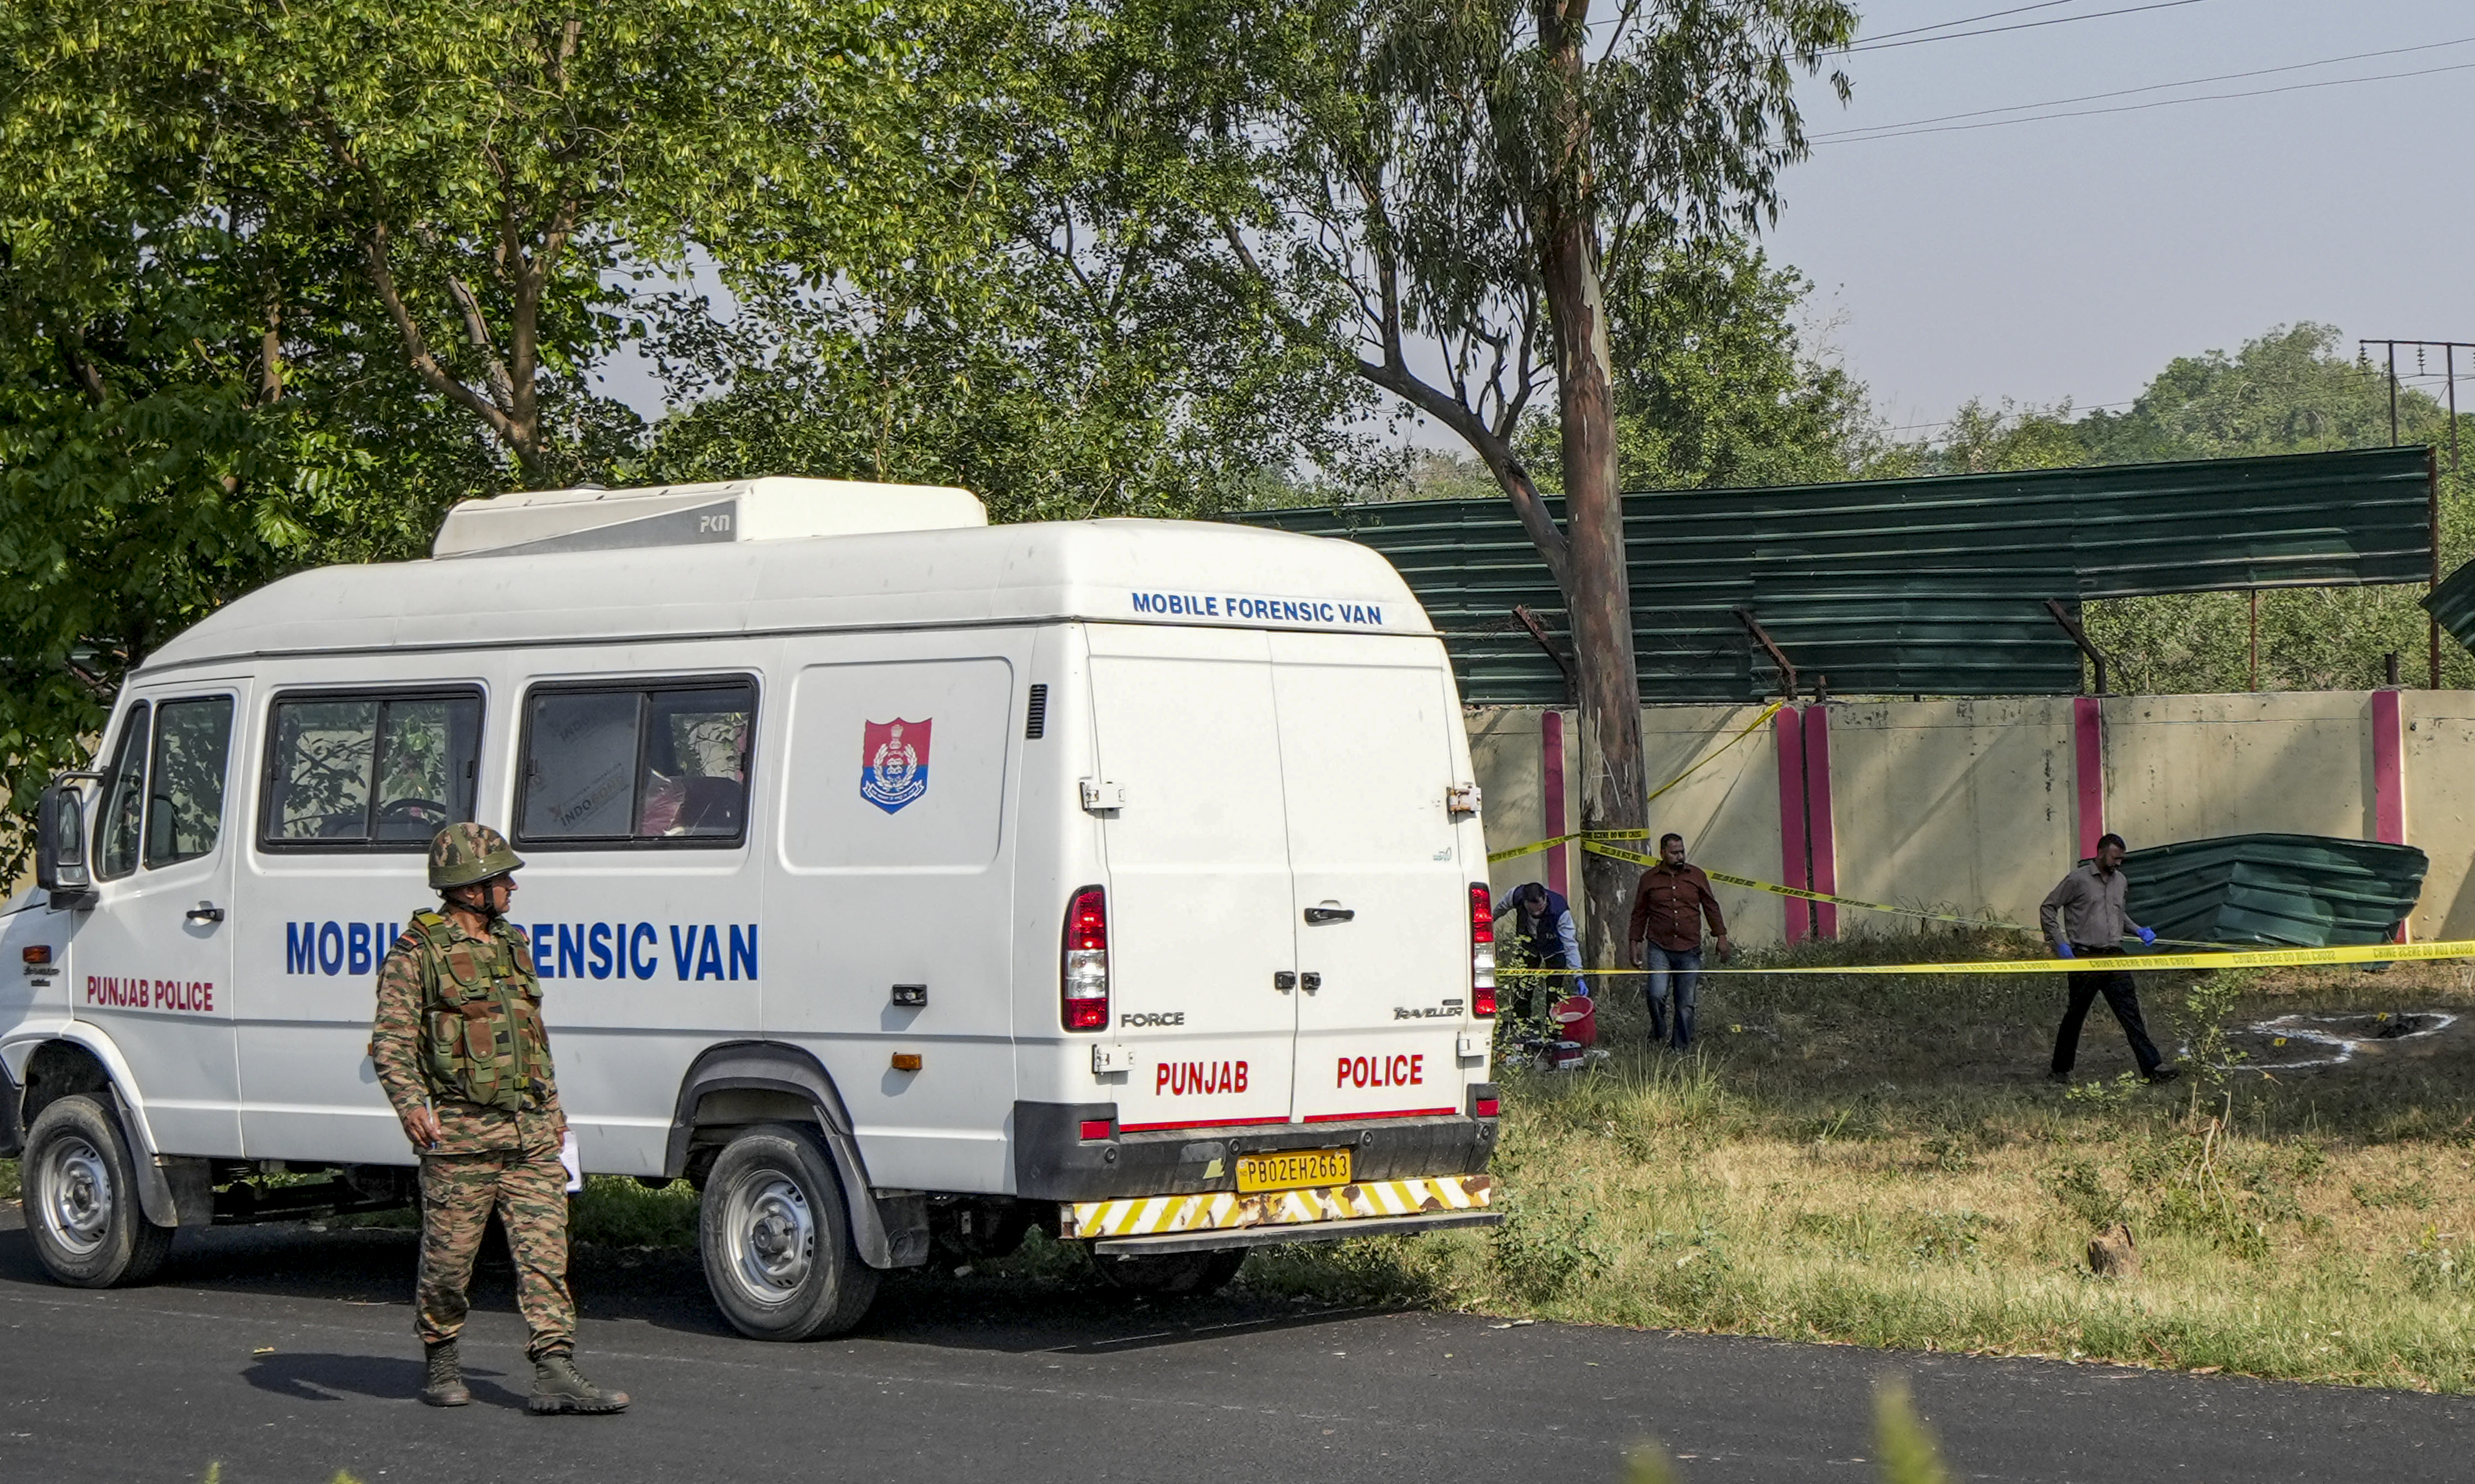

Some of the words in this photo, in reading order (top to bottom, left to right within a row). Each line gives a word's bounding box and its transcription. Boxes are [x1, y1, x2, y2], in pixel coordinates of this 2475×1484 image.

[1132, 592, 1219, 616] MOBILE
[1225, 597, 1334, 623] FORENSIC
[1338, 604, 1383, 625] VAN
[287, 921, 399, 976] MOBI
[512, 922, 658, 980] ENSIC
[669, 924, 757, 980] VAN
[87, 975, 149, 1008] PUNJAB
[155, 980, 213, 1011] POLICE
[1121, 1012, 1184, 1027] FORCE
[1156, 1060, 1248, 1096] PUNJAB
[1337, 1054, 1423, 1088] POLICE
[1248, 1155, 1347, 1184] PB02EH2663
